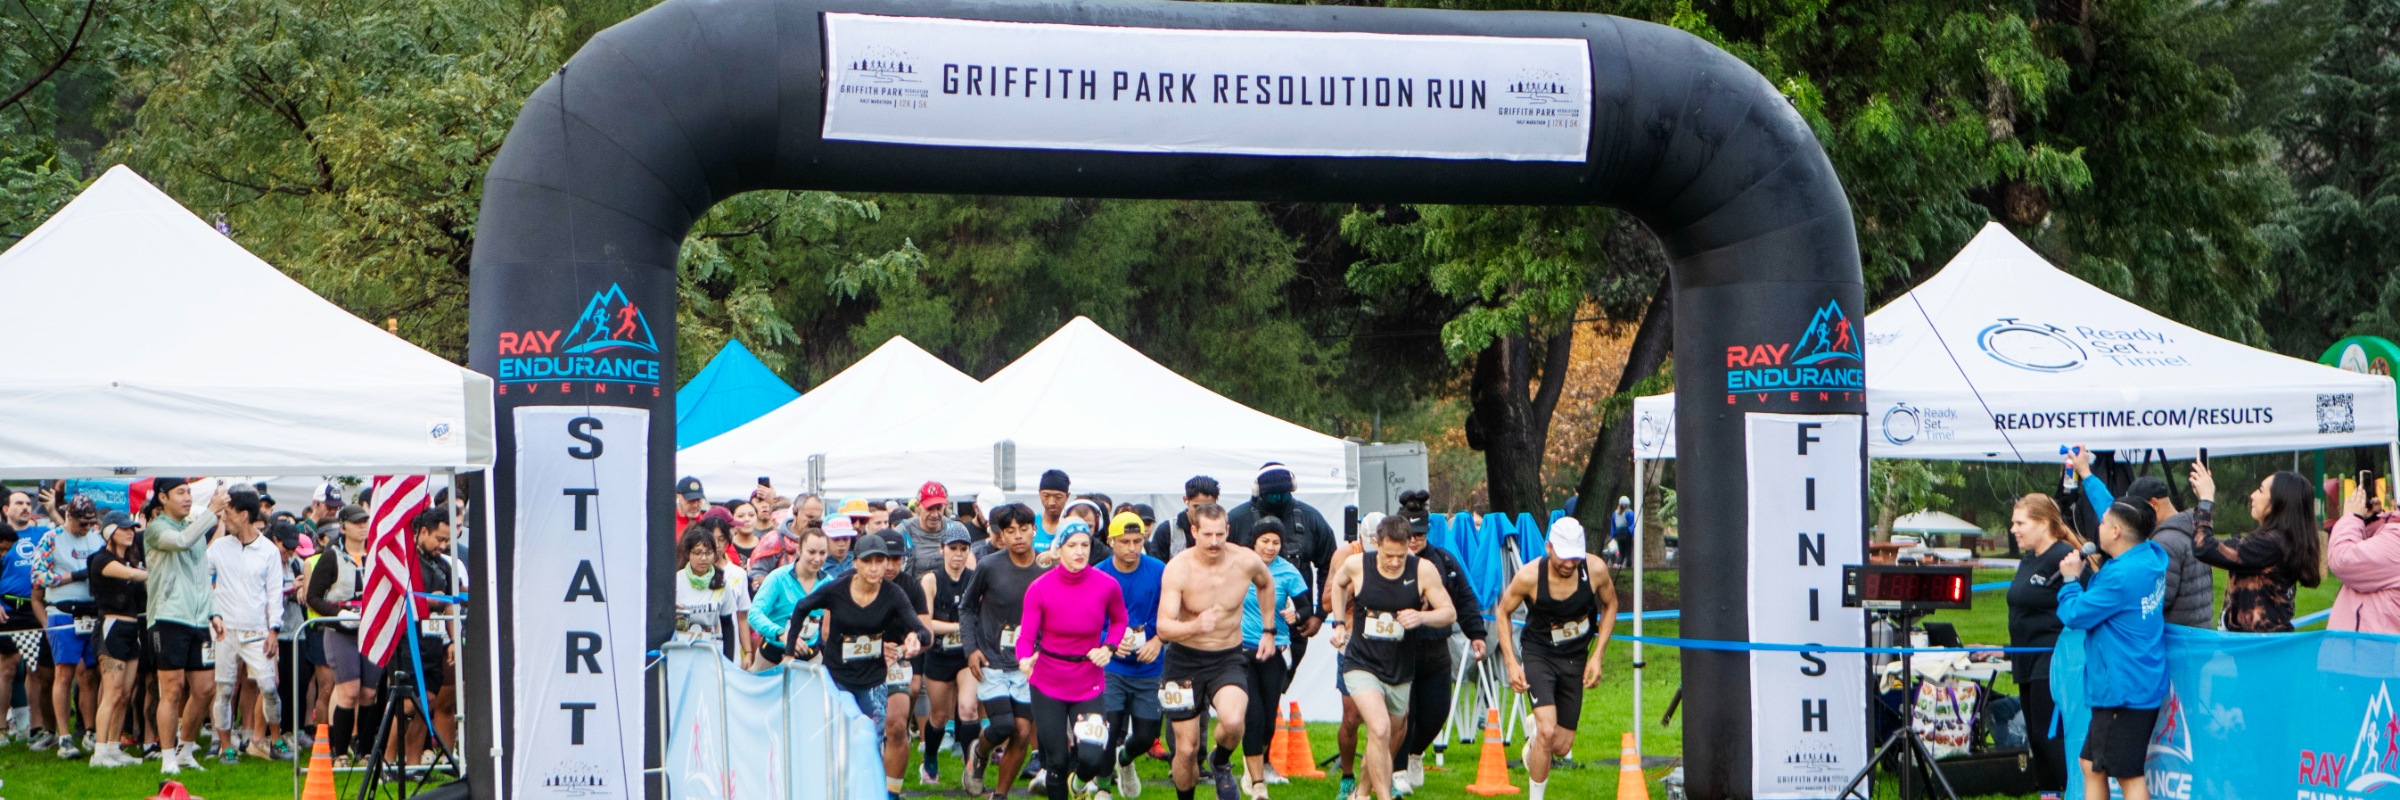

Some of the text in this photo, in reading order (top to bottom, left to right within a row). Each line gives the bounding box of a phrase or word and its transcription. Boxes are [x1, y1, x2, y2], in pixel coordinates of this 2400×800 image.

[840, 84, 903, 97] GRIFFITH PARK
[943, 63, 1486, 109] GRIFFITH PARK RESOLUTION RUN
[1498, 107, 1556, 117] GRIFFITH PARK
[1552, 120, 1563, 128] 12K
[2075, 325, 2175, 344] Ready,
[499, 330, 562, 355] RAY
[1727, 343, 1790, 367] RAY
[499, 357, 660, 380] ENDURANCE
[1727, 367, 1864, 389] ENDURANCE
[499, 382, 661, 397] EVENTS
[1727, 391, 1865, 405] EVENTS
[1923, 406, 1958, 419] Ready,
[1994, 406, 2273, 430] READYSETTIME.COM/RESULTS
[1925, 429, 1955, 441] Time!
[560, 416, 606, 746] START
[1797, 422, 1828, 733] FINISH
[1375, 621, 1394, 635] 54
[1562, 627, 1580, 638] 51
[853, 642, 873, 656] 29
[888, 668, 905, 682] 65
[1164, 691, 1183, 705] 90
[1084, 723, 1104, 738] 30
[2298, 749, 2347, 788] RAY
